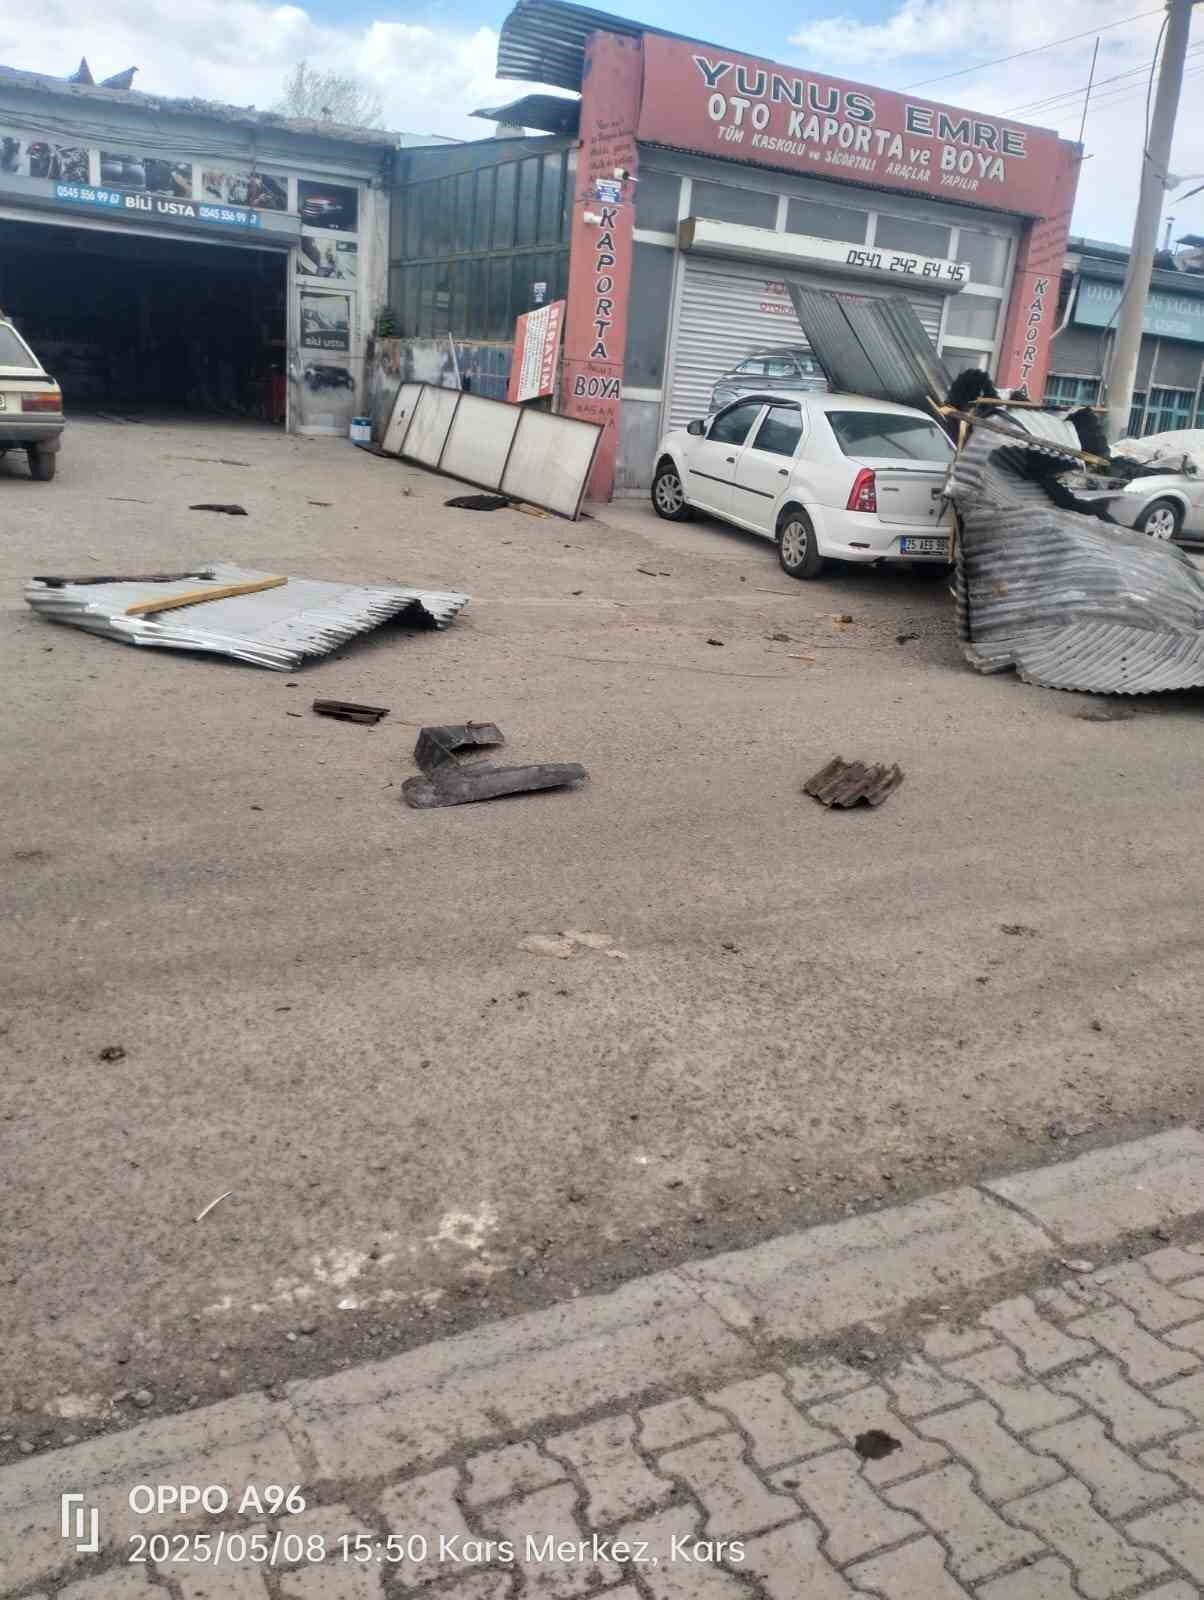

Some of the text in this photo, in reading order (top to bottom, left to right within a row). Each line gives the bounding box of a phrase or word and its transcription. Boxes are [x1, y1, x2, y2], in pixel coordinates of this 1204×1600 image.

[692, 55, 1027, 158] YUNUS EMRE
[708, 93, 1005, 182] OTO KAPORTA ve BOYA
[717, 126, 745, 143] TÜM
[752, 134, 807, 154] KASKOLU
[940, 173, 979, 191] YAPILIR
[125, 194, 196, 217] BİLİ USTA
[590, 206, 618, 359] KAPORTA
[846, 249, 966, 281] 0541 242 64 45
[1016, 278, 1049, 399] KAPORTA
[573, 376, 621, 400] BOYA
